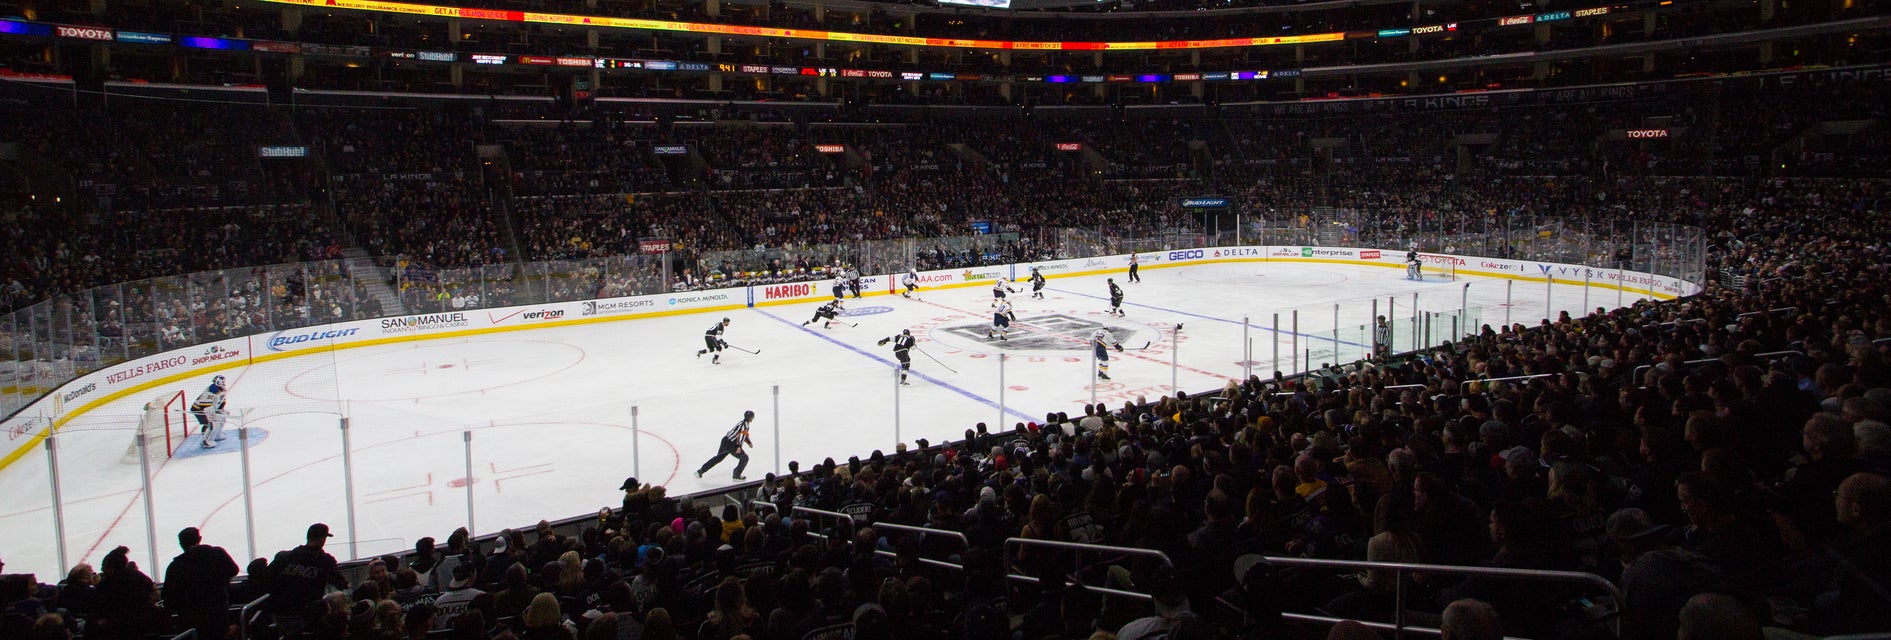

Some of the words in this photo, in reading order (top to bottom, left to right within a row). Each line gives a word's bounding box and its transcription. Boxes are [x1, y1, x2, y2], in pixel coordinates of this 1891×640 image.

[1544, 12, 1571, 20] DELTA
[1575, 7, 1607, 18] STAPLES
[57, 27, 113, 40] TOYOTA
[1412, 25, 1444, 34] TOYOTA
[420, 53, 453, 61] StubHub!
[557, 58, 592, 66] TOSHIBA
[262, 147, 304, 156] StubHub!
[816, 145, 844, 153] TOSHIBA
[640, 243, 670, 251] STAPLES
[1168, 249, 1203, 261] GEICO
[1303, 249, 1353, 258] enterprise
[1430, 256, 1466, 266] TOYOTA
[1481, 261, 1499, 269] Coke
[914, 273, 953, 284] AAA.com
[1608, 273, 1638, 284] WELLS
[765, 283, 809, 299] HARIBO
[677, 296, 701, 304] KONICA
[702, 294, 728, 302] MINOLTA
[618, 300, 654, 309] RESORTS
[523, 309, 564, 321] verizon
[381, 318, 407, 330] SAN
[417, 313, 468, 327] MANUEL
[272, 333, 310, 347] BUD
[310, 328, 360, 341] LIGHT
[192, 350, 240, 367] SHOP.NHL.COM
[106, 367, 144, 385] WELLS
[146, 355, 187, 374] FARGO
[64, 382, 97, 403] McDonald's
